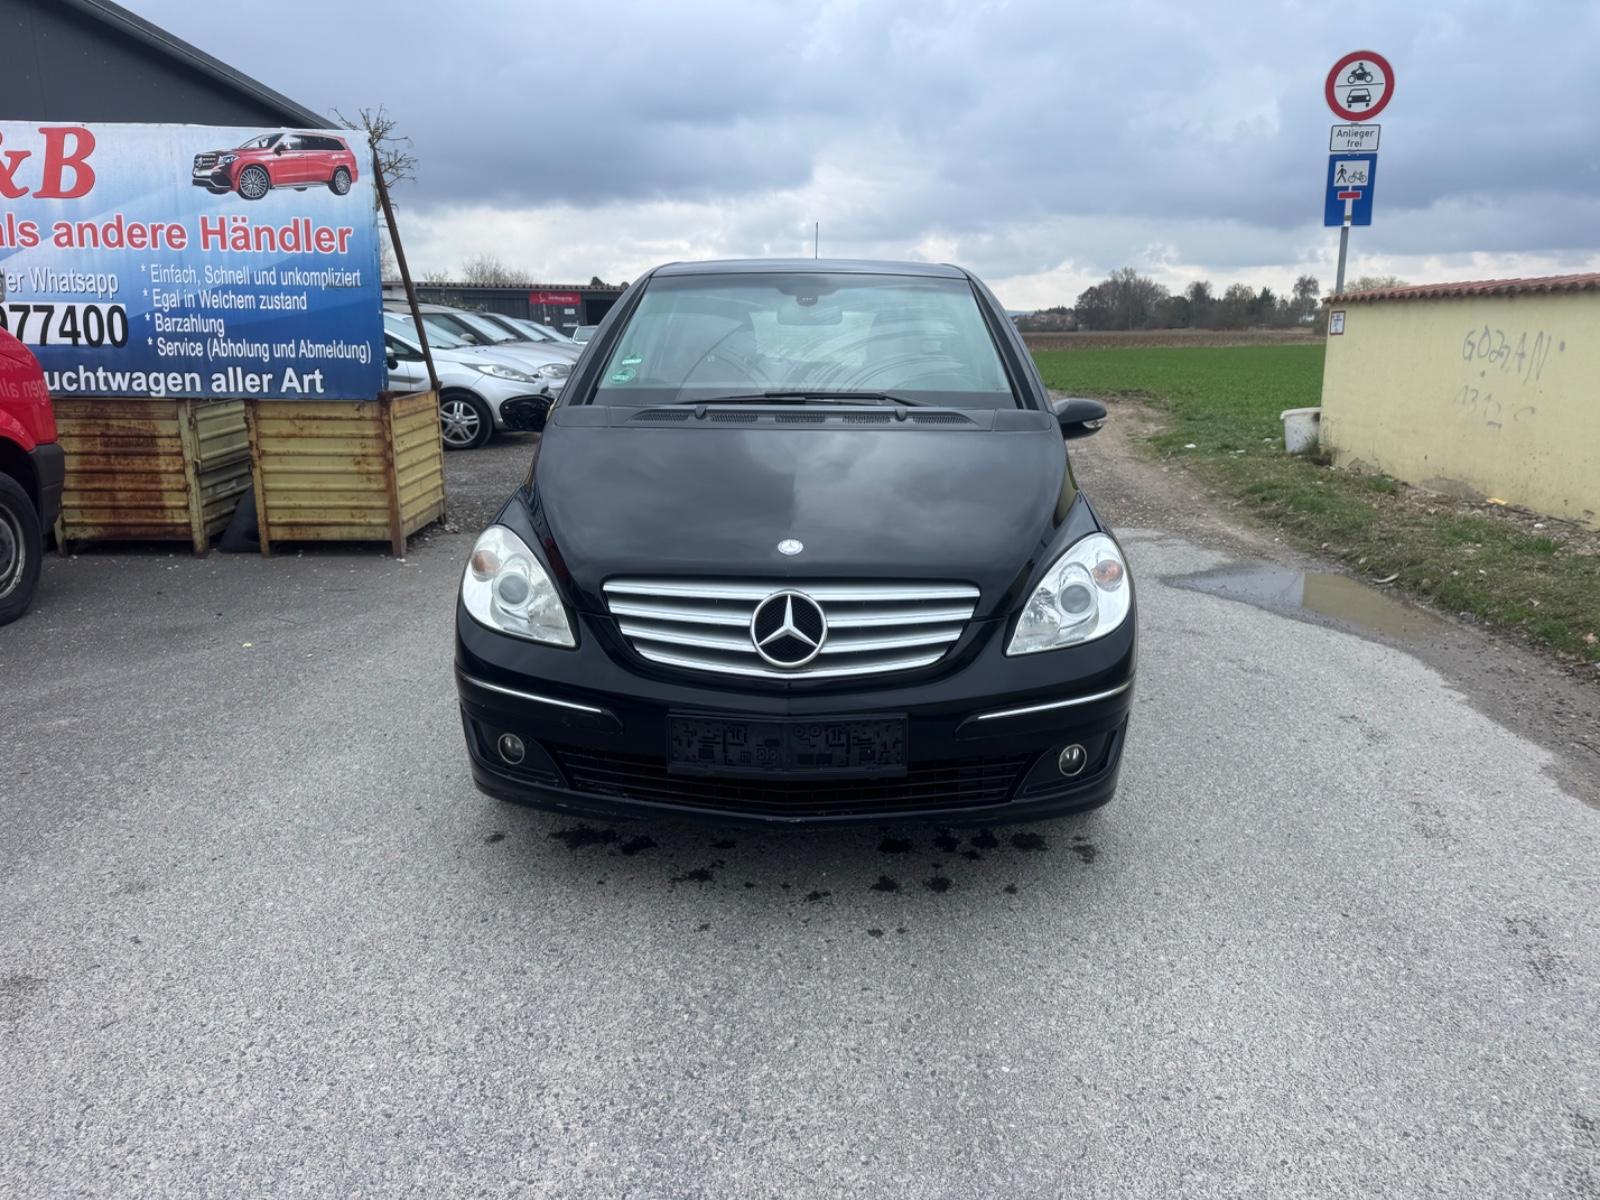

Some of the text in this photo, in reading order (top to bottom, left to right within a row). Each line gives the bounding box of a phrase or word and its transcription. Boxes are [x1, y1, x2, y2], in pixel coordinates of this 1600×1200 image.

[1336, 129, 1376, 139] Anlieger
[1346, 139, 1362, 148] frei
[0, 213, 353, 252] ls andere Händler
[0, 266, 119, 299] er Whatsapp
[150, 263, 361, 290] Einfach, Schnell und unkompliziert
[152, 288, 308, 313] Egal in Welchem zustand
[154, 312, 225, 338] Barzahlung
[157, 336, 372, 364] Service (Abholung und Abmeldung)
[211, 367, 273, 394] aller
[280, 367, 325, 394] Art
